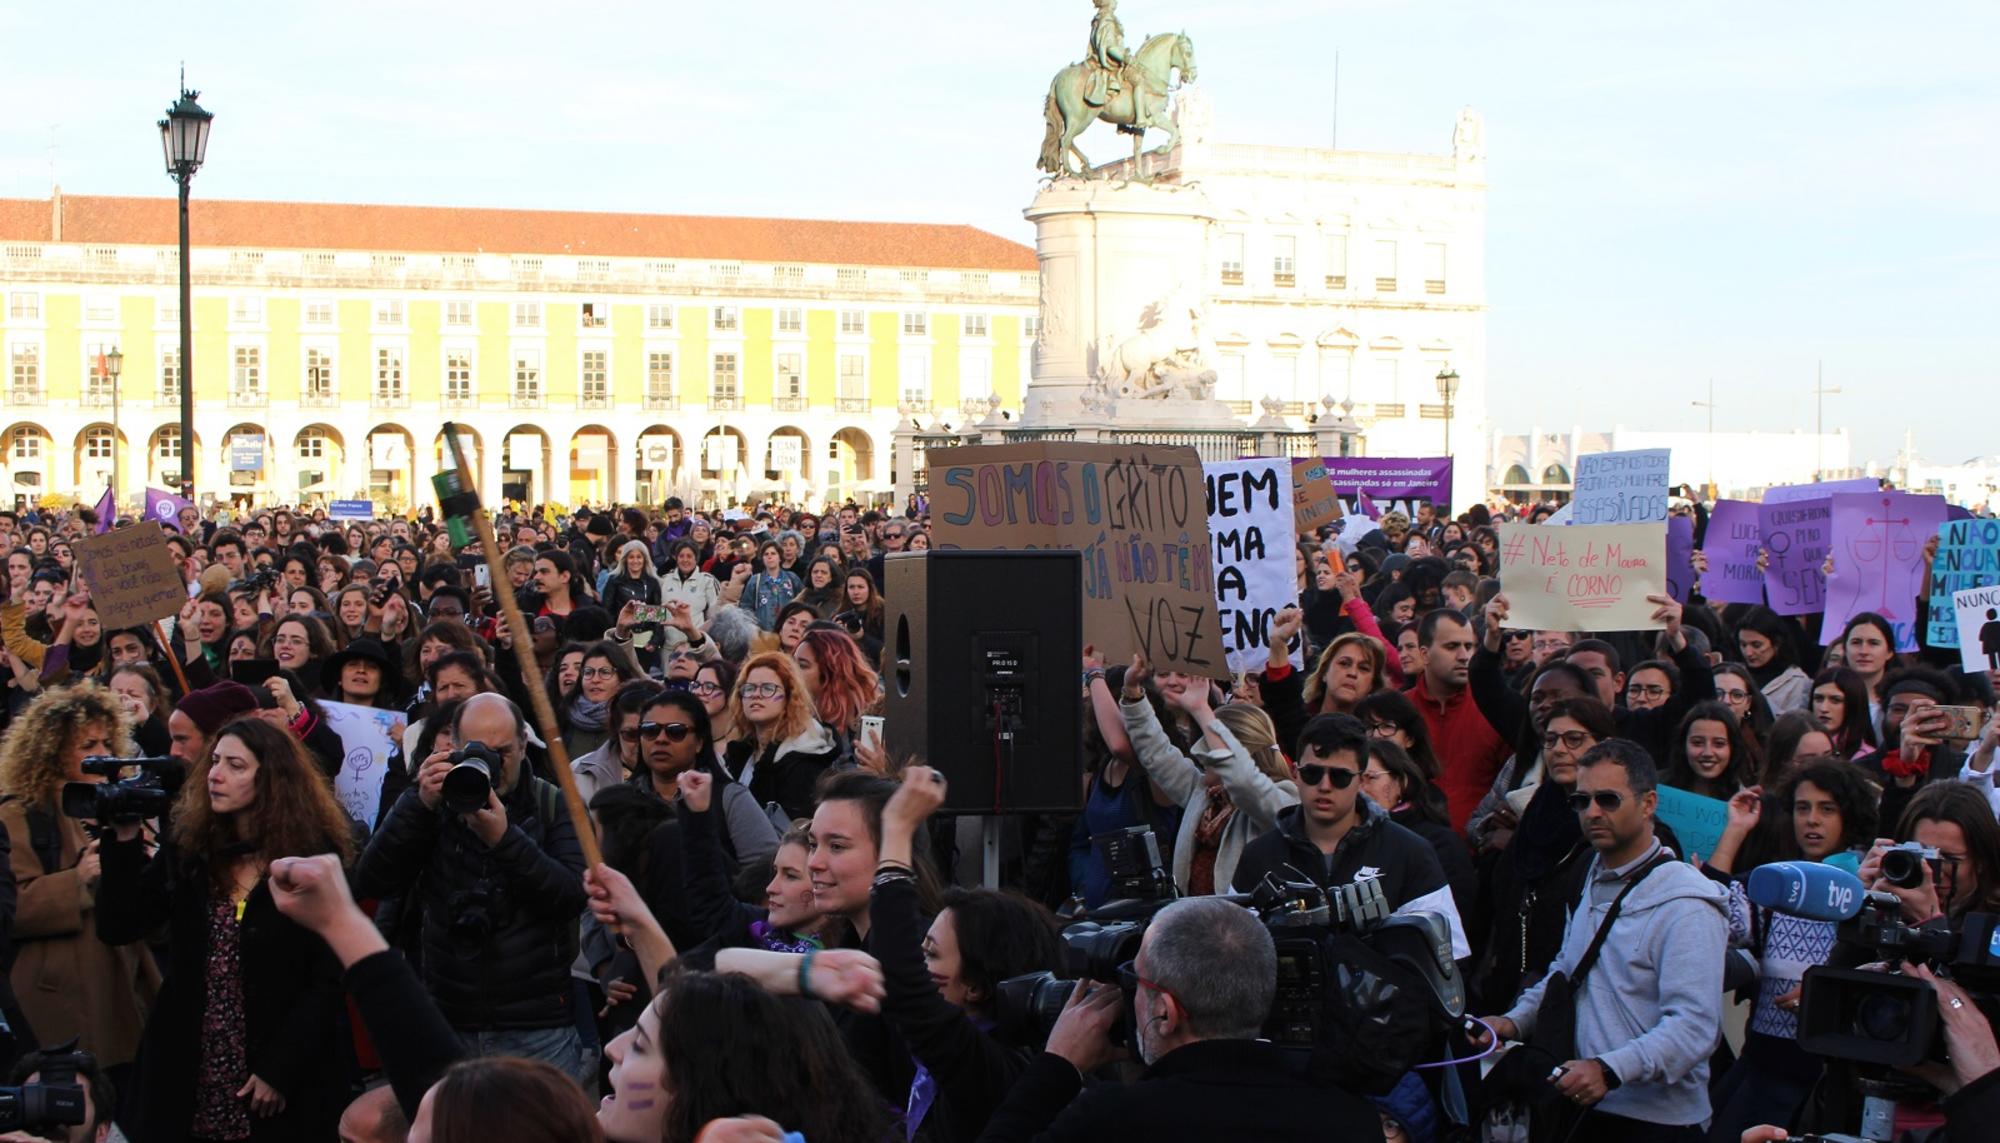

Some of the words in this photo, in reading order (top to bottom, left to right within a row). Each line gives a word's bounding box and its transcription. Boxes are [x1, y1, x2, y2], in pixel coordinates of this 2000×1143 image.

[1337, 467, 1377, 476] mulheres
[1378, 468, 1432, 476] assassinadas
[1407, 480, 1439, 488] Janeiro
[943, 460, 1075, 527] SOMOS
[1082, 462, 1101, 525] O
[1104, 454, 1188, 535] GRITO
[1293, 490, 1308, 505] RE
[1573, 492, 1668, 524] ASSASSINADAS
[1731, 523, 1760, 540] LUCH
[1209, 526, 1265, 564] MA
[1579, 542, 1600, 568] de
[1606, 543, 1648, 569] Moura
[1745, 544, 1762, 558] PA
[1083, 531, 1112, 600] JÁ
[1115, 532, 1159, 584] NÃO
[1162, 532, 1210, 592] TÊM
[1217, 565, 1246, 602] A
[1545, 571, 1559, 593] É
[1567, 574, 1623, 597] CORNO
[1956, 590, 2000, 608] NUNC
[1928, 606, 1956, 622] MES
[1124, 594, 1211, 666] VOZ
[1788, 881, 1801, 903] tve
[1828, 880, 1852, 914] tve
